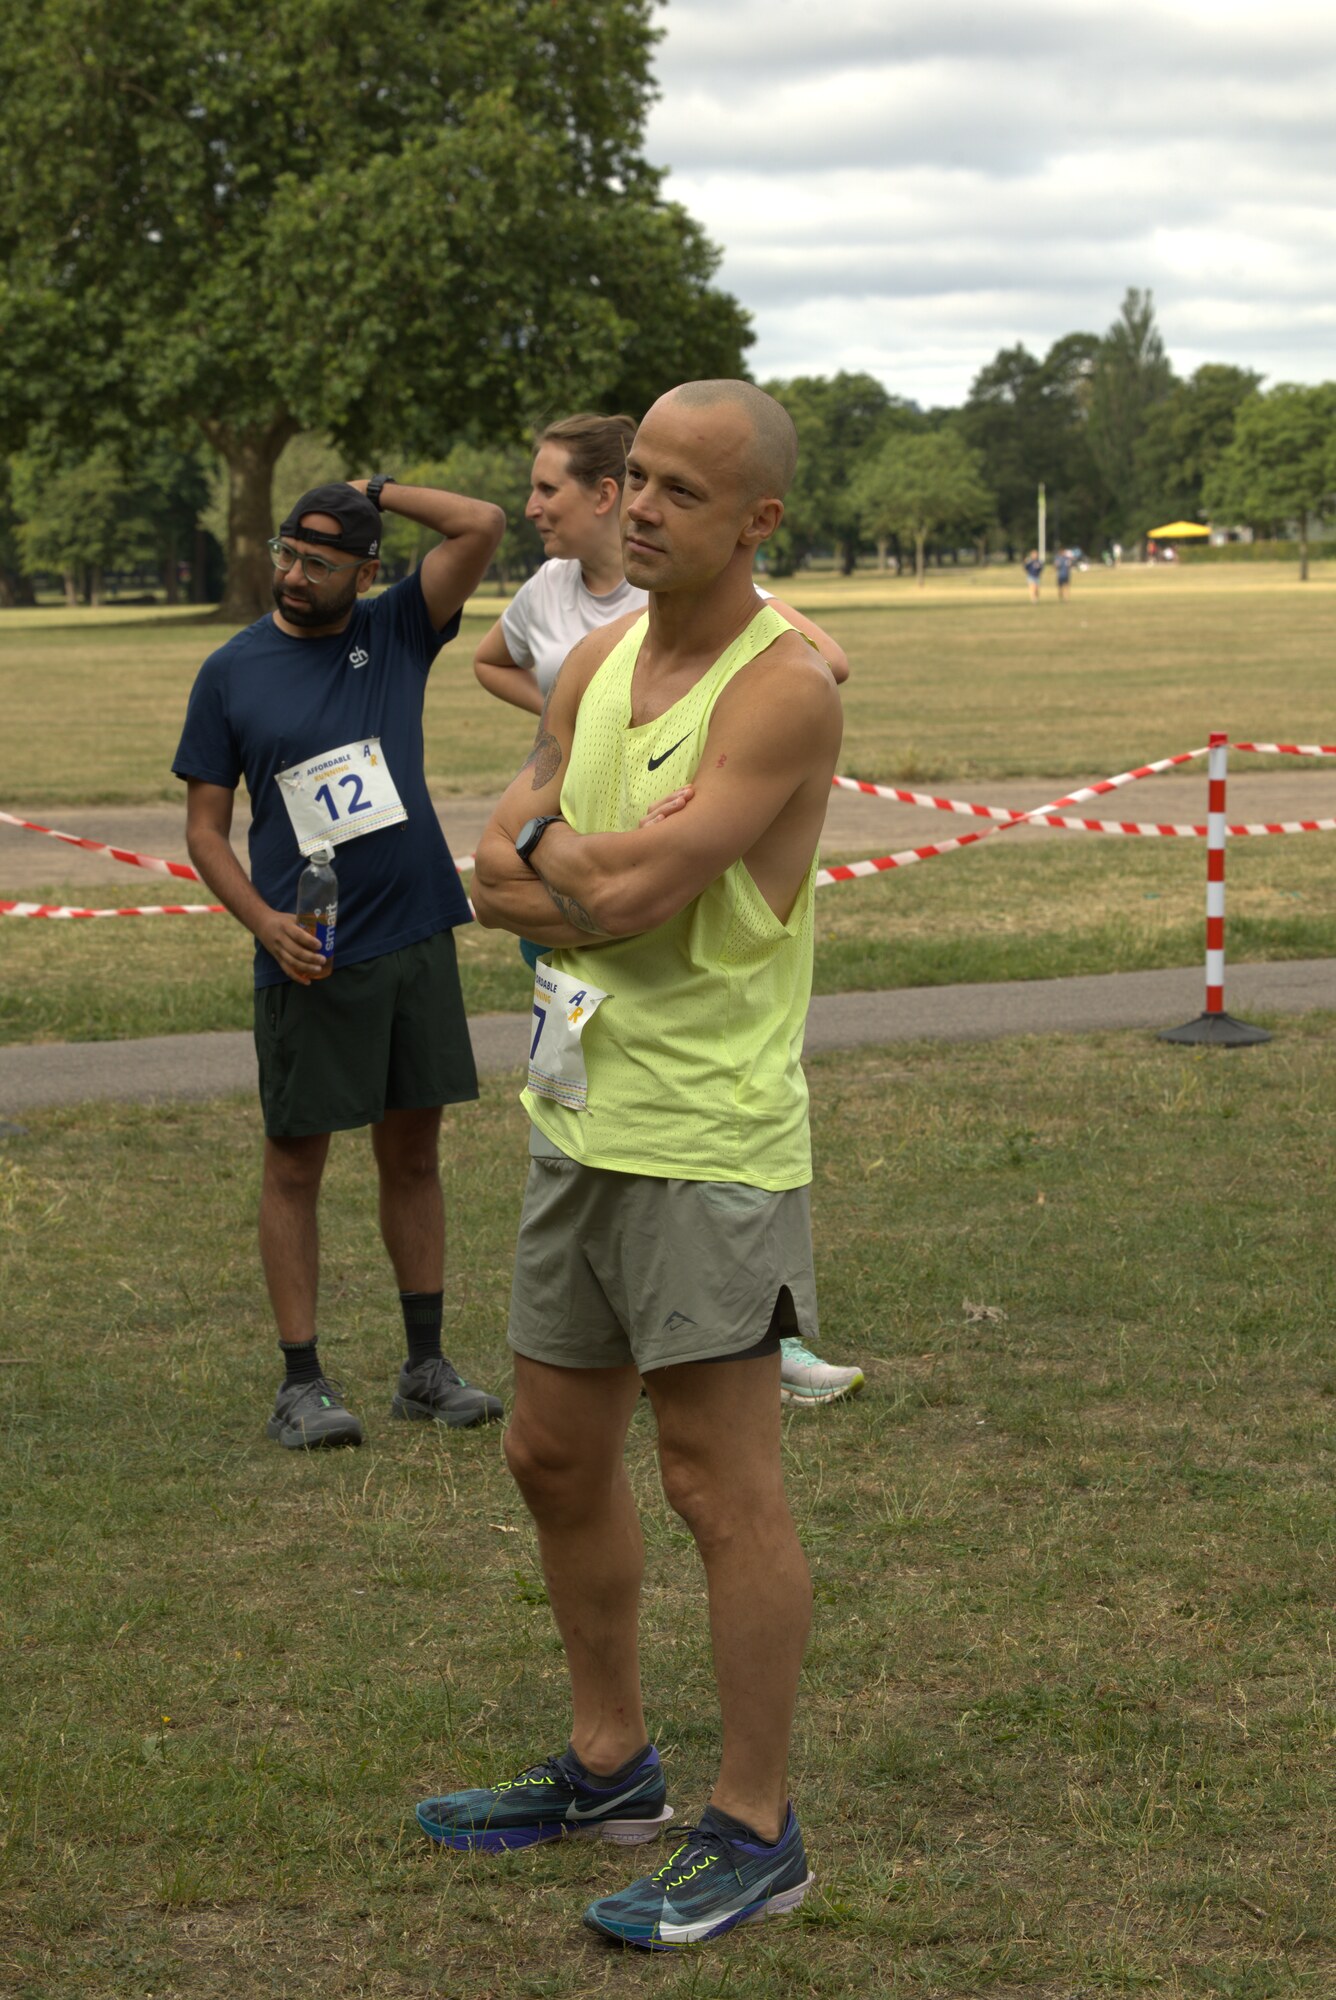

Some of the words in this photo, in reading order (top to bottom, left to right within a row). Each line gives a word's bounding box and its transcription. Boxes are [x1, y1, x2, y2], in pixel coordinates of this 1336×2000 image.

[306, 754, 351, 776] AFFORDABLE
[314, 764, 350, 782] RUNNING
[314, 773, 373, 821] 12
[325, 901, 338, 951] smart
[568, 990, 587, 1007] A
[568, 1007, 584, 1024] R
